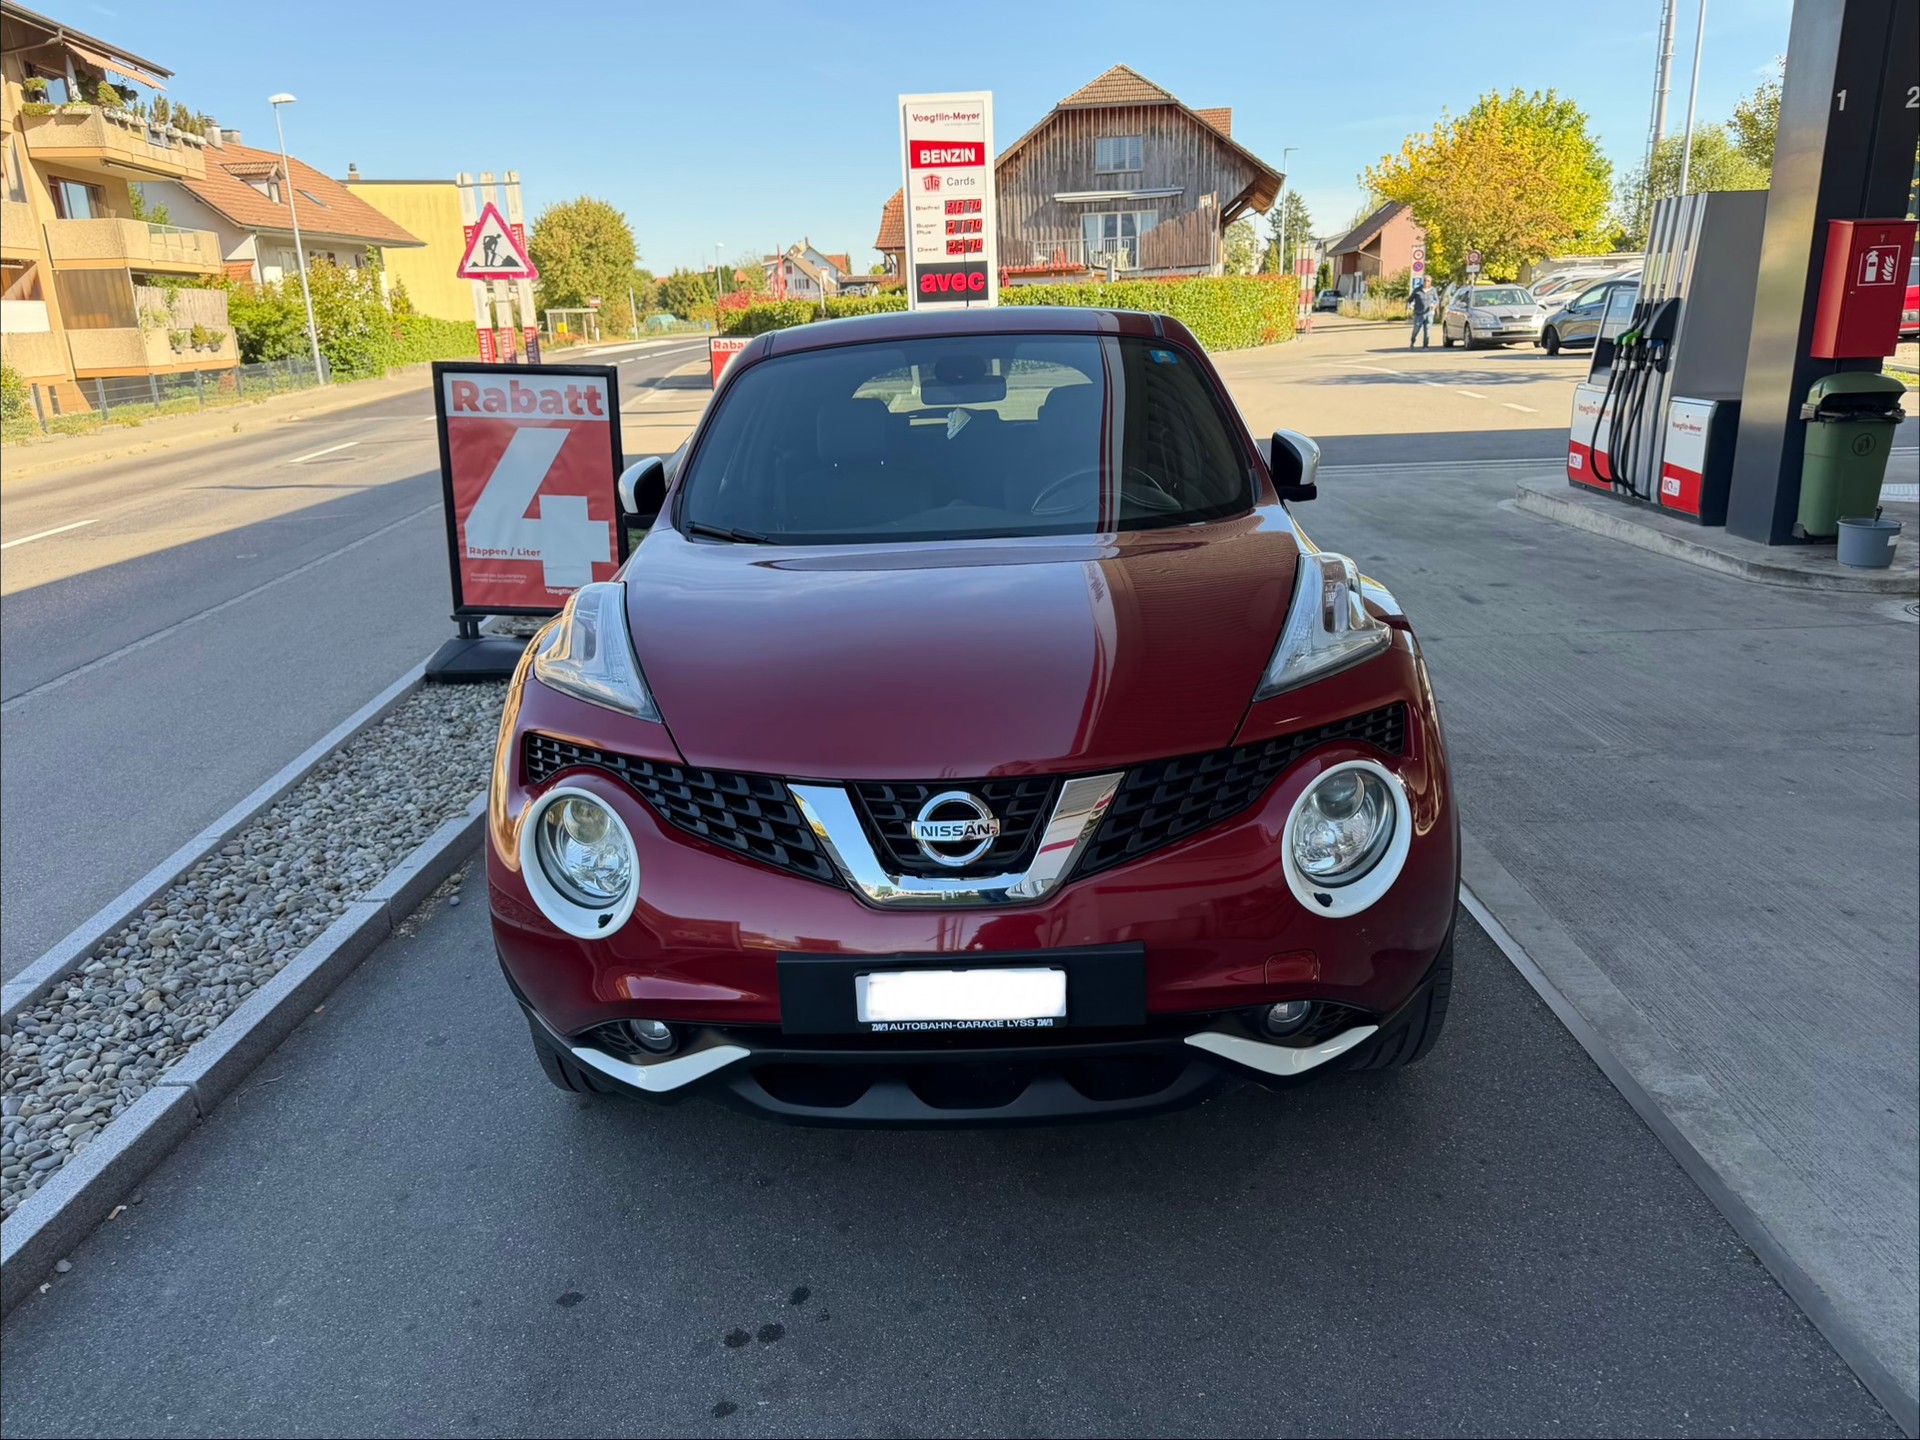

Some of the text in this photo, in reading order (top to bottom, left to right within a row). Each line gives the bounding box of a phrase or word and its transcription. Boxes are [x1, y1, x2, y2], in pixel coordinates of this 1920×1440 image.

[1837, 89, 1847, 111] 1
[1905, 86, 1919, 108] 2
[912, 112, 980, 123] Voegtlin-Meyer
[919, 148, 976, 164] BENZIN
[946, 176, 976, 187] Cards
[920, 271, 985, 293] avec
[451, 379, 605, 416] Rabatt
[464, 427, 611, 588] 4
[469, 546, 541, 557] Rappen / Liter
[921, 823, 991, 838] NISSAN
[889, 1020, 1004, 1031] AUTOBAHN-GARAGE
[1006, 1019, 1035, 1028] LYSS
